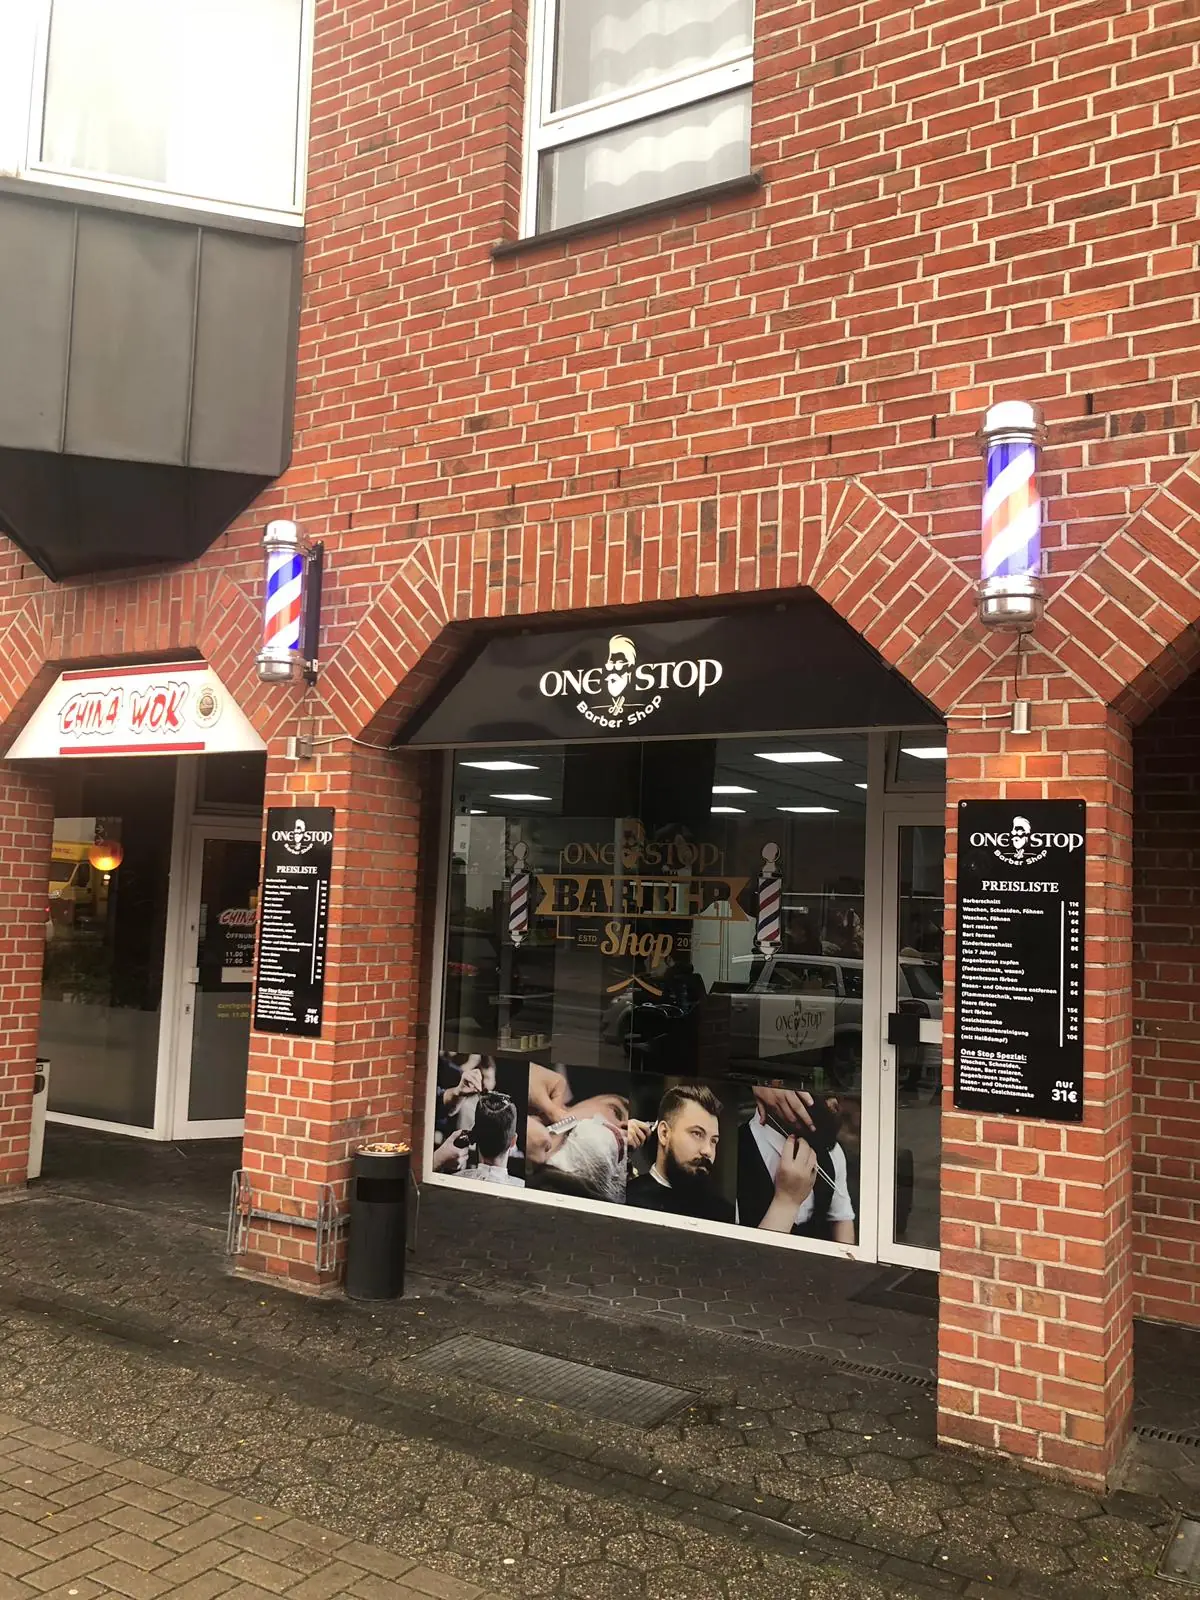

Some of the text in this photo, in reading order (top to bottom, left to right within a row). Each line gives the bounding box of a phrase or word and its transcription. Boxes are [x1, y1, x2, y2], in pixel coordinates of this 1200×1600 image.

[539, 659, 722, 697] ONE STOP
[62, 690, 122, 732] CHINA
[131, 685, 187, 731] WOK
[576, 695, 661, 728] Barber Shop
[272, 831, 332, 845] ONE STOP
[970, 833, 1083, 852] ONE STOP
[564, 842, 718, 873] ONE STOP
[994, 849, 1047, 865] Barber Shop
[276, 866, 317, 874] PREISLISTE
[982, 881, 1059, 892] PREISLISTE
[578, 934, 597, 942] ESTD
[601, 921, 673, 967] Shop
[962, 940, 1012, 948] Kinderhaarschnitt
[962, 966, 1003, 974] (Fadentechnik,
[962, 974, 998, 982] Augenbrauen
[305, 1014, 318, 1024] 31€
[961, 1017, 1002, 1025] Gesichtsmaske
[977, 1050, 994, 1059] Stop
[997, 1052, 1027, 1060] Spezial:
[961, 1086, 1034, 1098] entfernen, Gesichtsmaske
[1052, 1089, 1077, 1103] 31€
